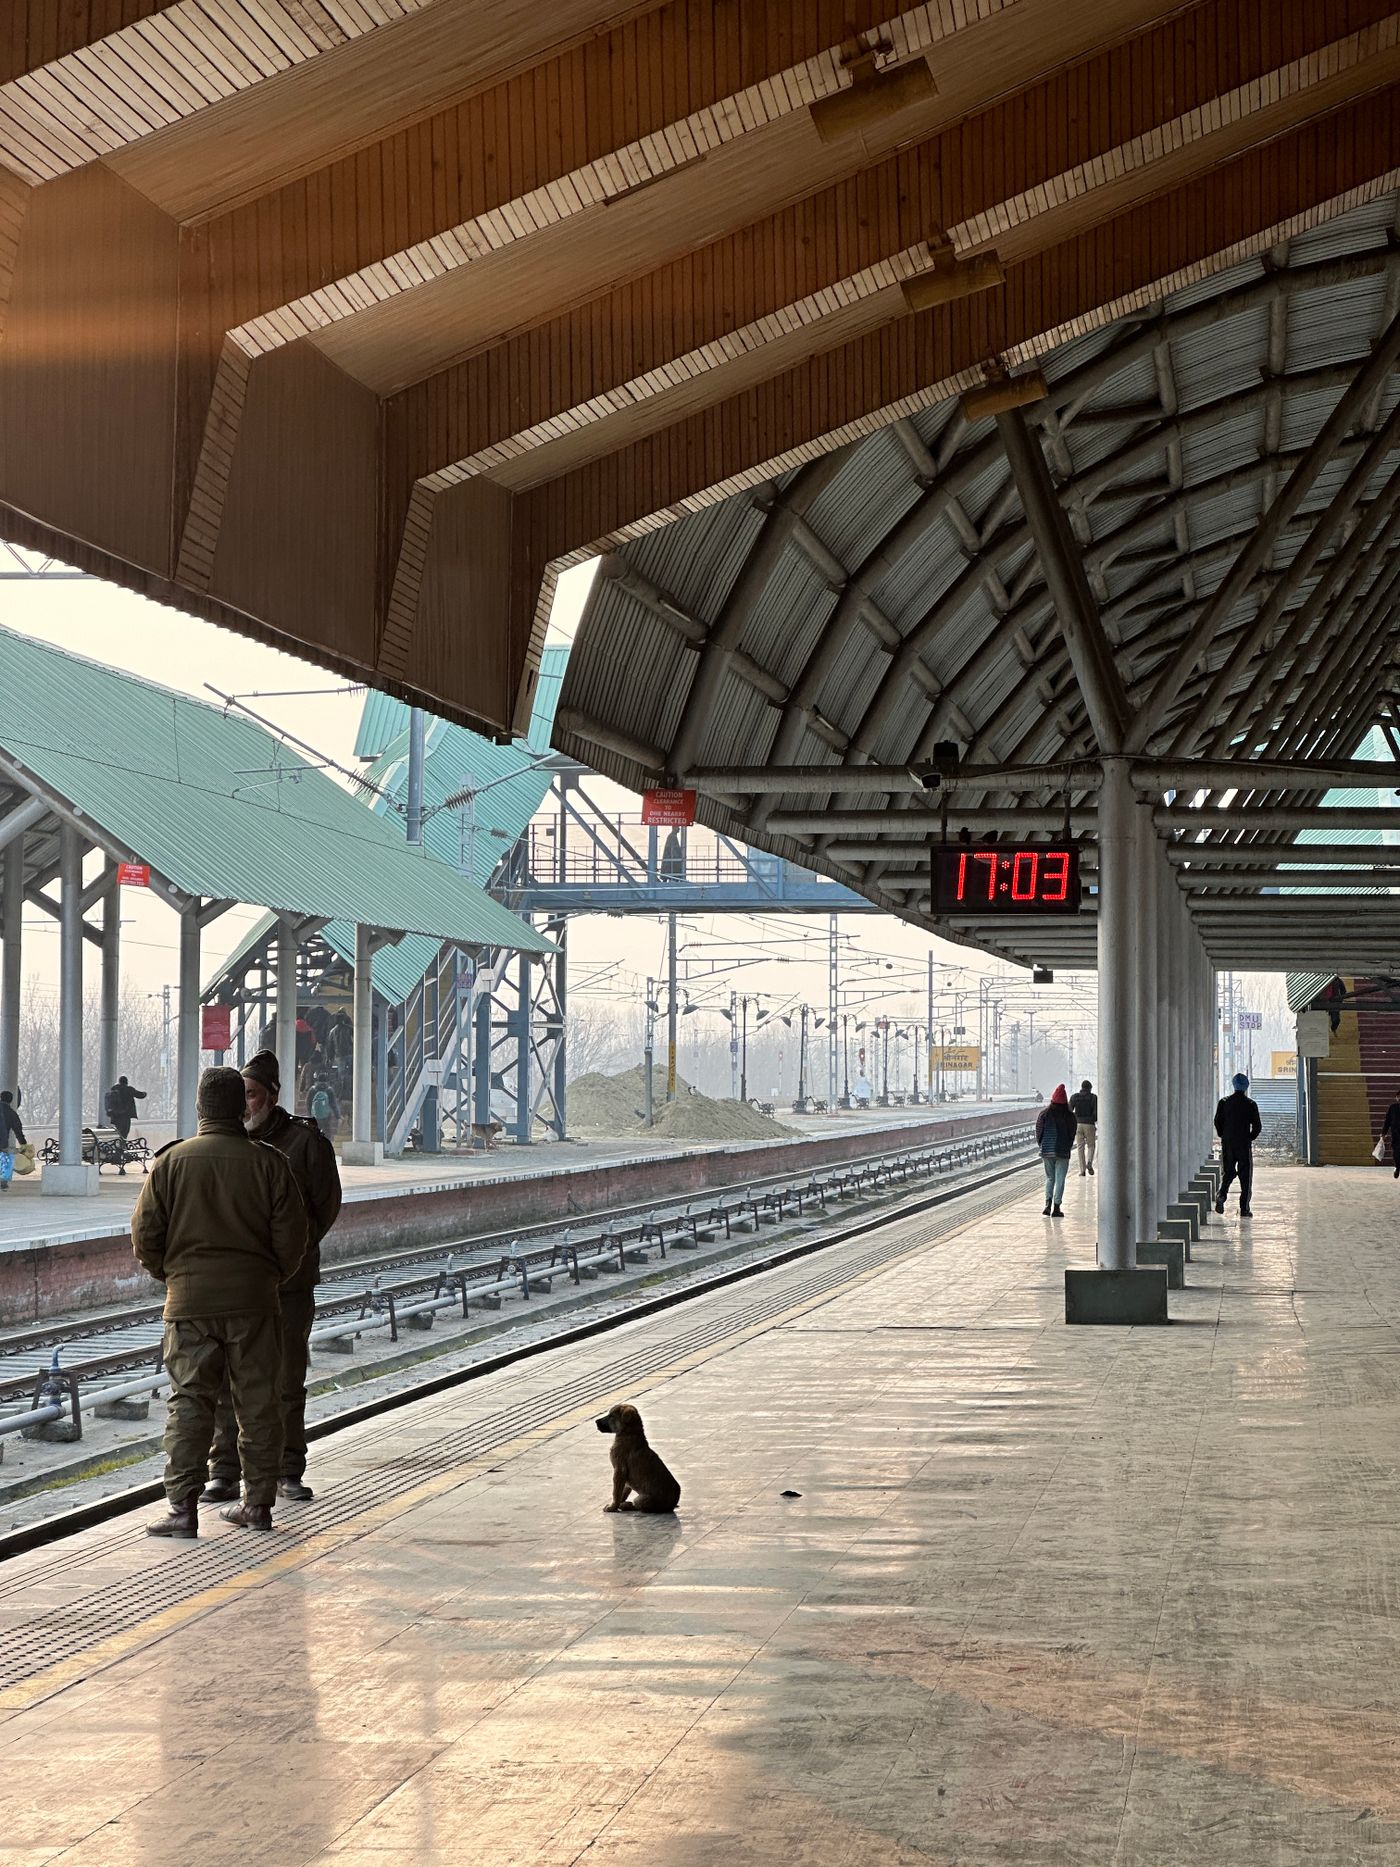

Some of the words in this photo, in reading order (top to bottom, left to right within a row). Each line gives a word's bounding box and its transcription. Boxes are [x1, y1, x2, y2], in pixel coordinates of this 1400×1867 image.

[655, 791, 683, 799] CAUTION
[956, 852, 1070, 900] 17:03
[1240, 1014, 1259, 1022] DMU
[1240, 1022, 1262, 1030] STOP
